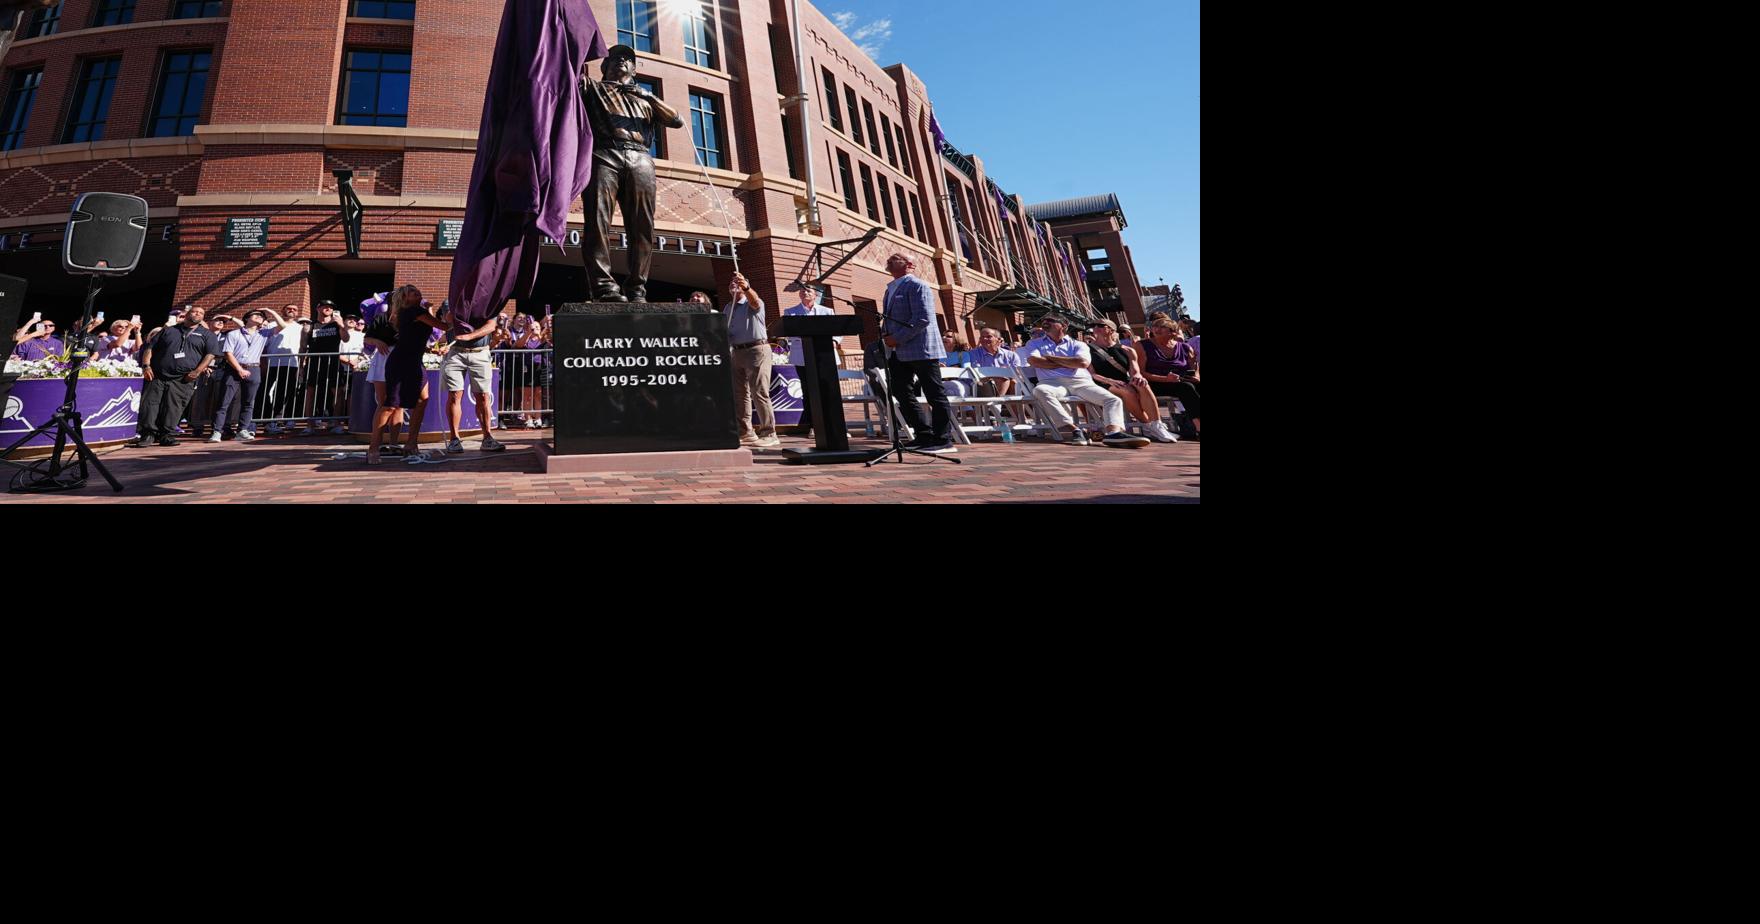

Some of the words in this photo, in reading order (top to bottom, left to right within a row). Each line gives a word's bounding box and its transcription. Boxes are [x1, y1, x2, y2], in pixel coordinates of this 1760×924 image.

[657, 236, 738, 258] PLATE
[585, 337, 634, 349] LARRY
[640, 337, 699, 348] WALKER
[563, 356, 649, 368] COLORADO
[655, 354, 722, 367] ROCKIES
[601, 374, 688, 387] 1995-2004
